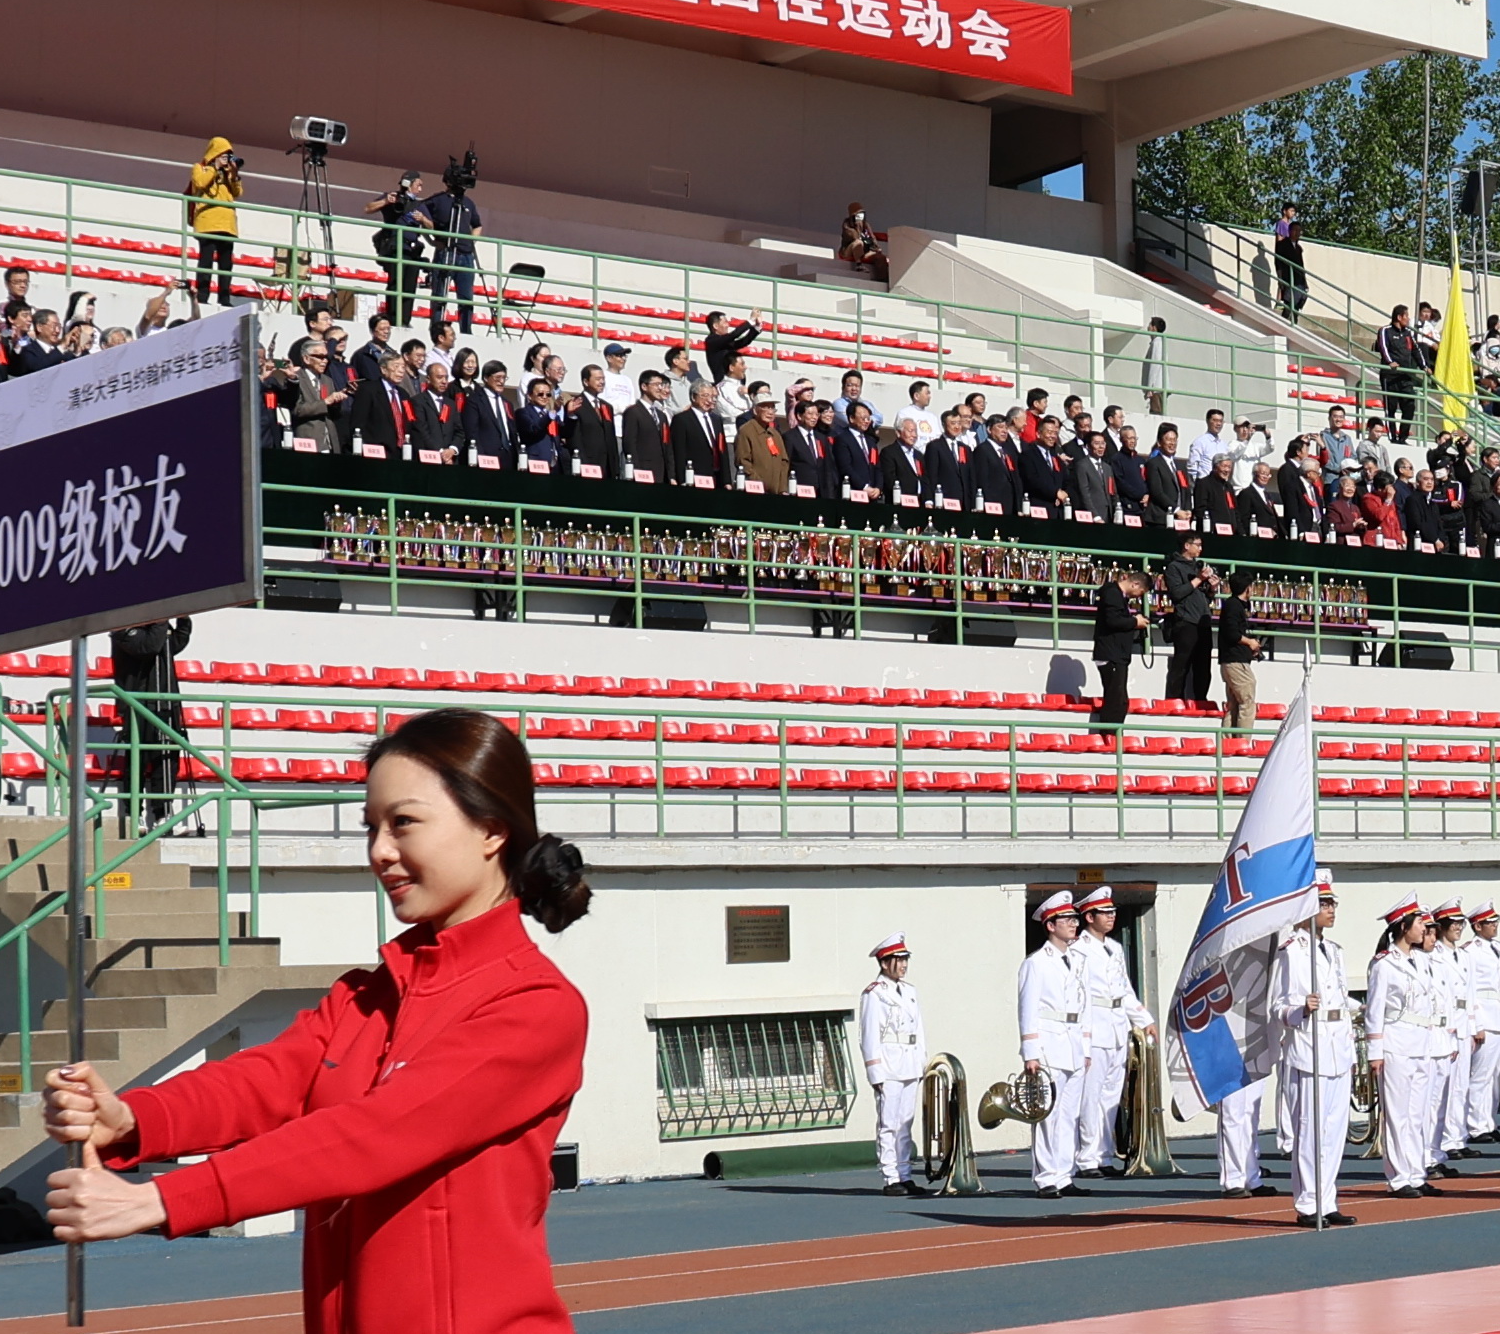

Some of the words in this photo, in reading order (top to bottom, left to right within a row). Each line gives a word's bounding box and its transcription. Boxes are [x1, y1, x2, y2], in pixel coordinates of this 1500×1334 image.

[68, 338, 242, 411] 清华大学马约翰杯学生运动会
